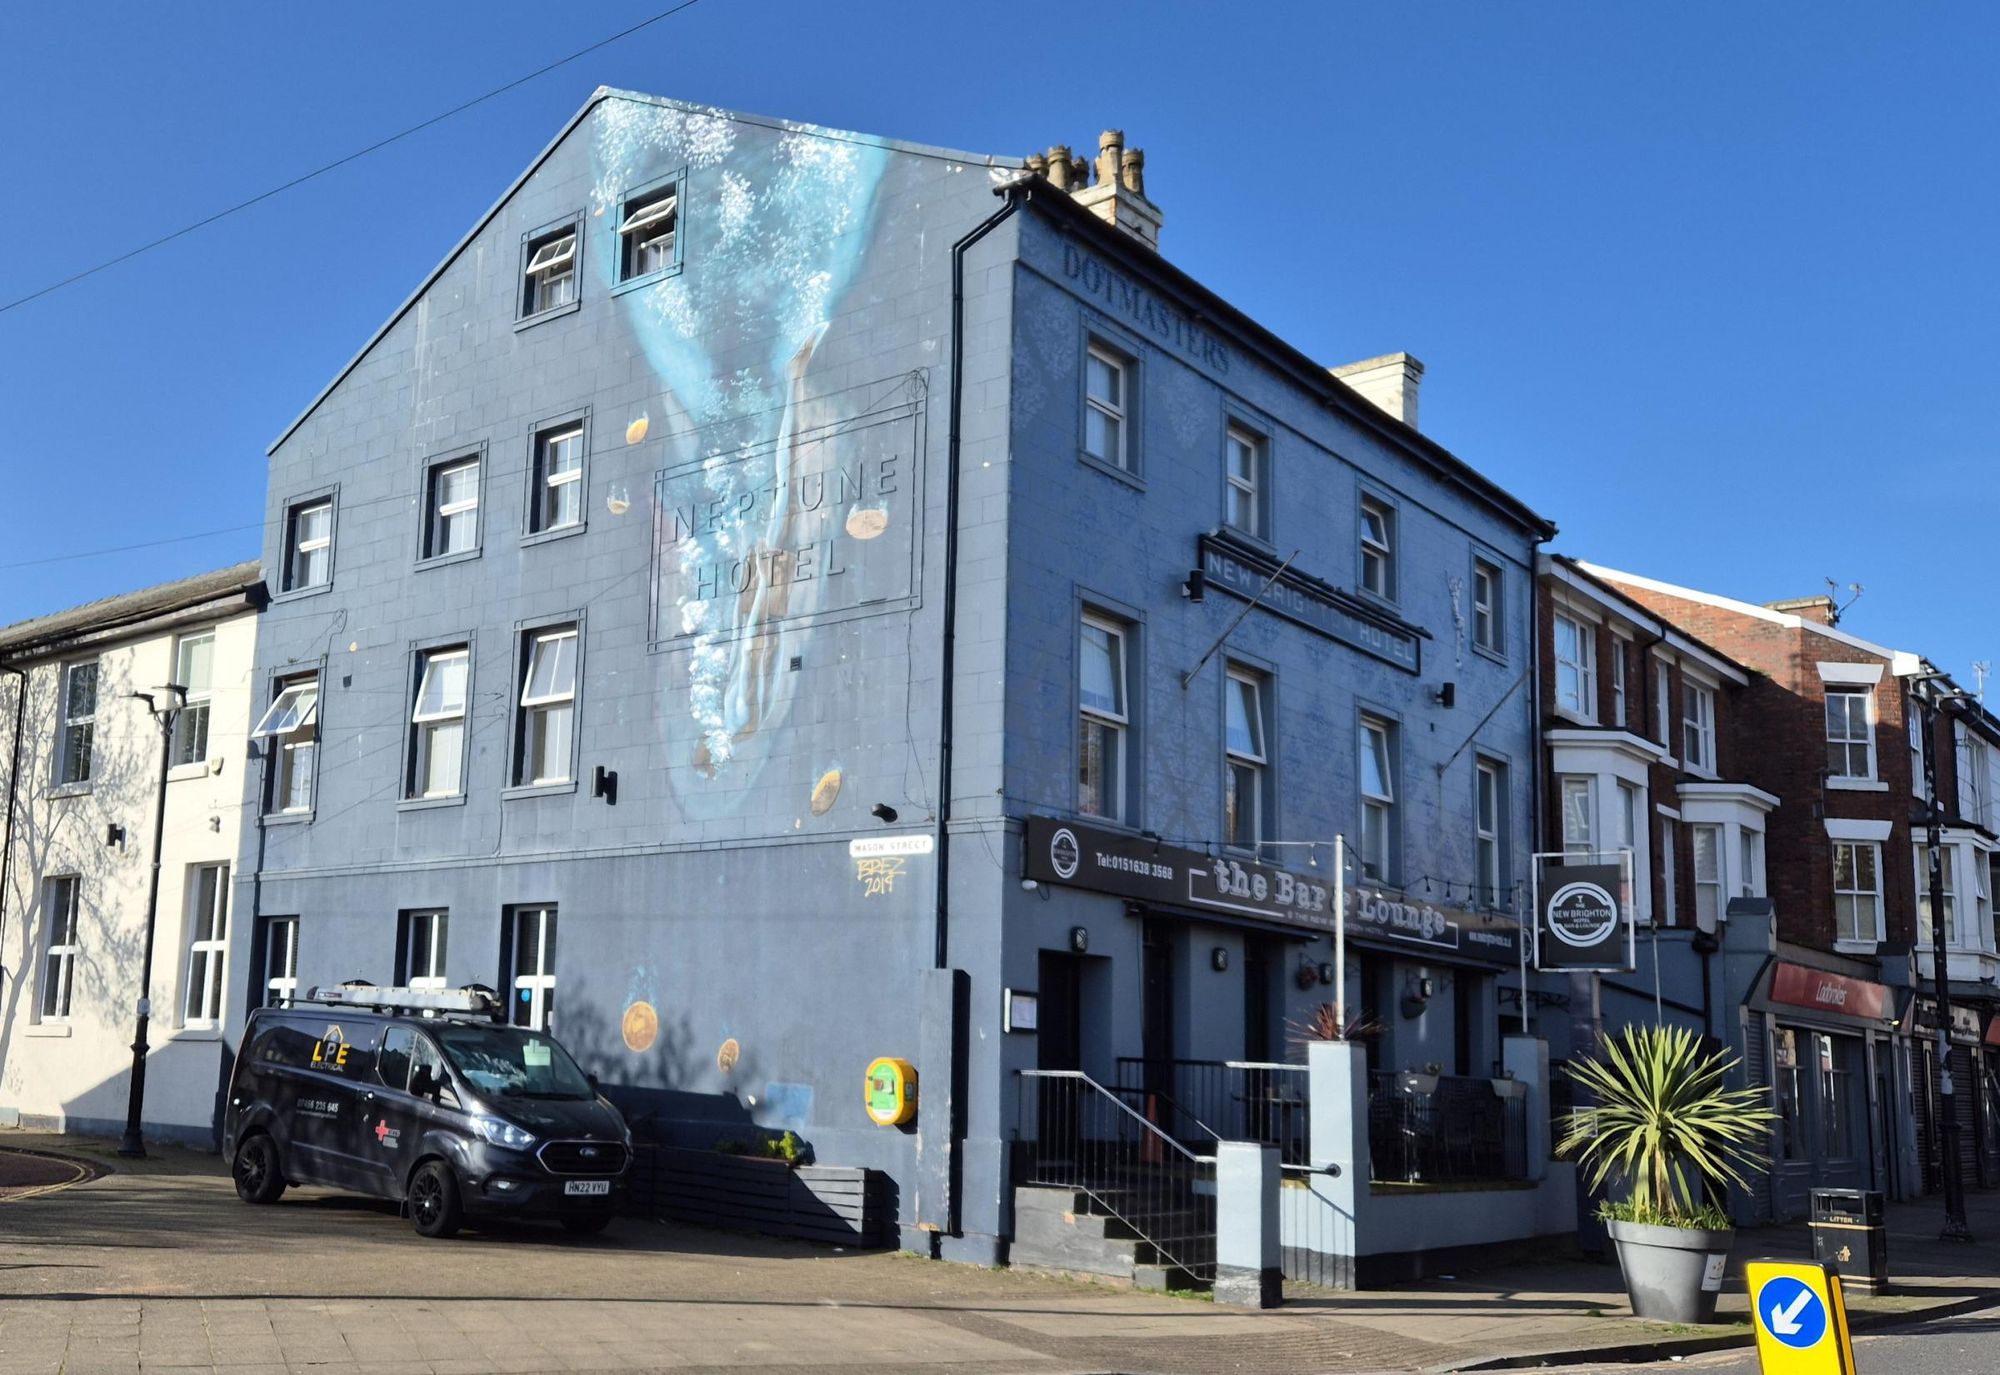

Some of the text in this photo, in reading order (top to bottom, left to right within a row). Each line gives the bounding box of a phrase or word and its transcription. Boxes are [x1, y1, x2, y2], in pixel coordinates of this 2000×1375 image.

[671, 454, 898, 543] NEPTUNE
[696, 539, 846, 600] HOTEL
[1208, 551, 1251, 588] NEW
[1360, 622, 1414, 663] HOTEL
[854, 839, 927, 852] MASON STREET
[864, 875, 894, 898] 2019
[1214, 858, 1269, 901] the
[1274, 870, 1326, 912] Bar
[1356, 887, 1446, 940] Lounge
[1552, 908, 1612, 919] NEW BRIGHTON
[312, 1040, 351, 1065] LPE
[1829, 1215, 1853, 1224] LITTER
